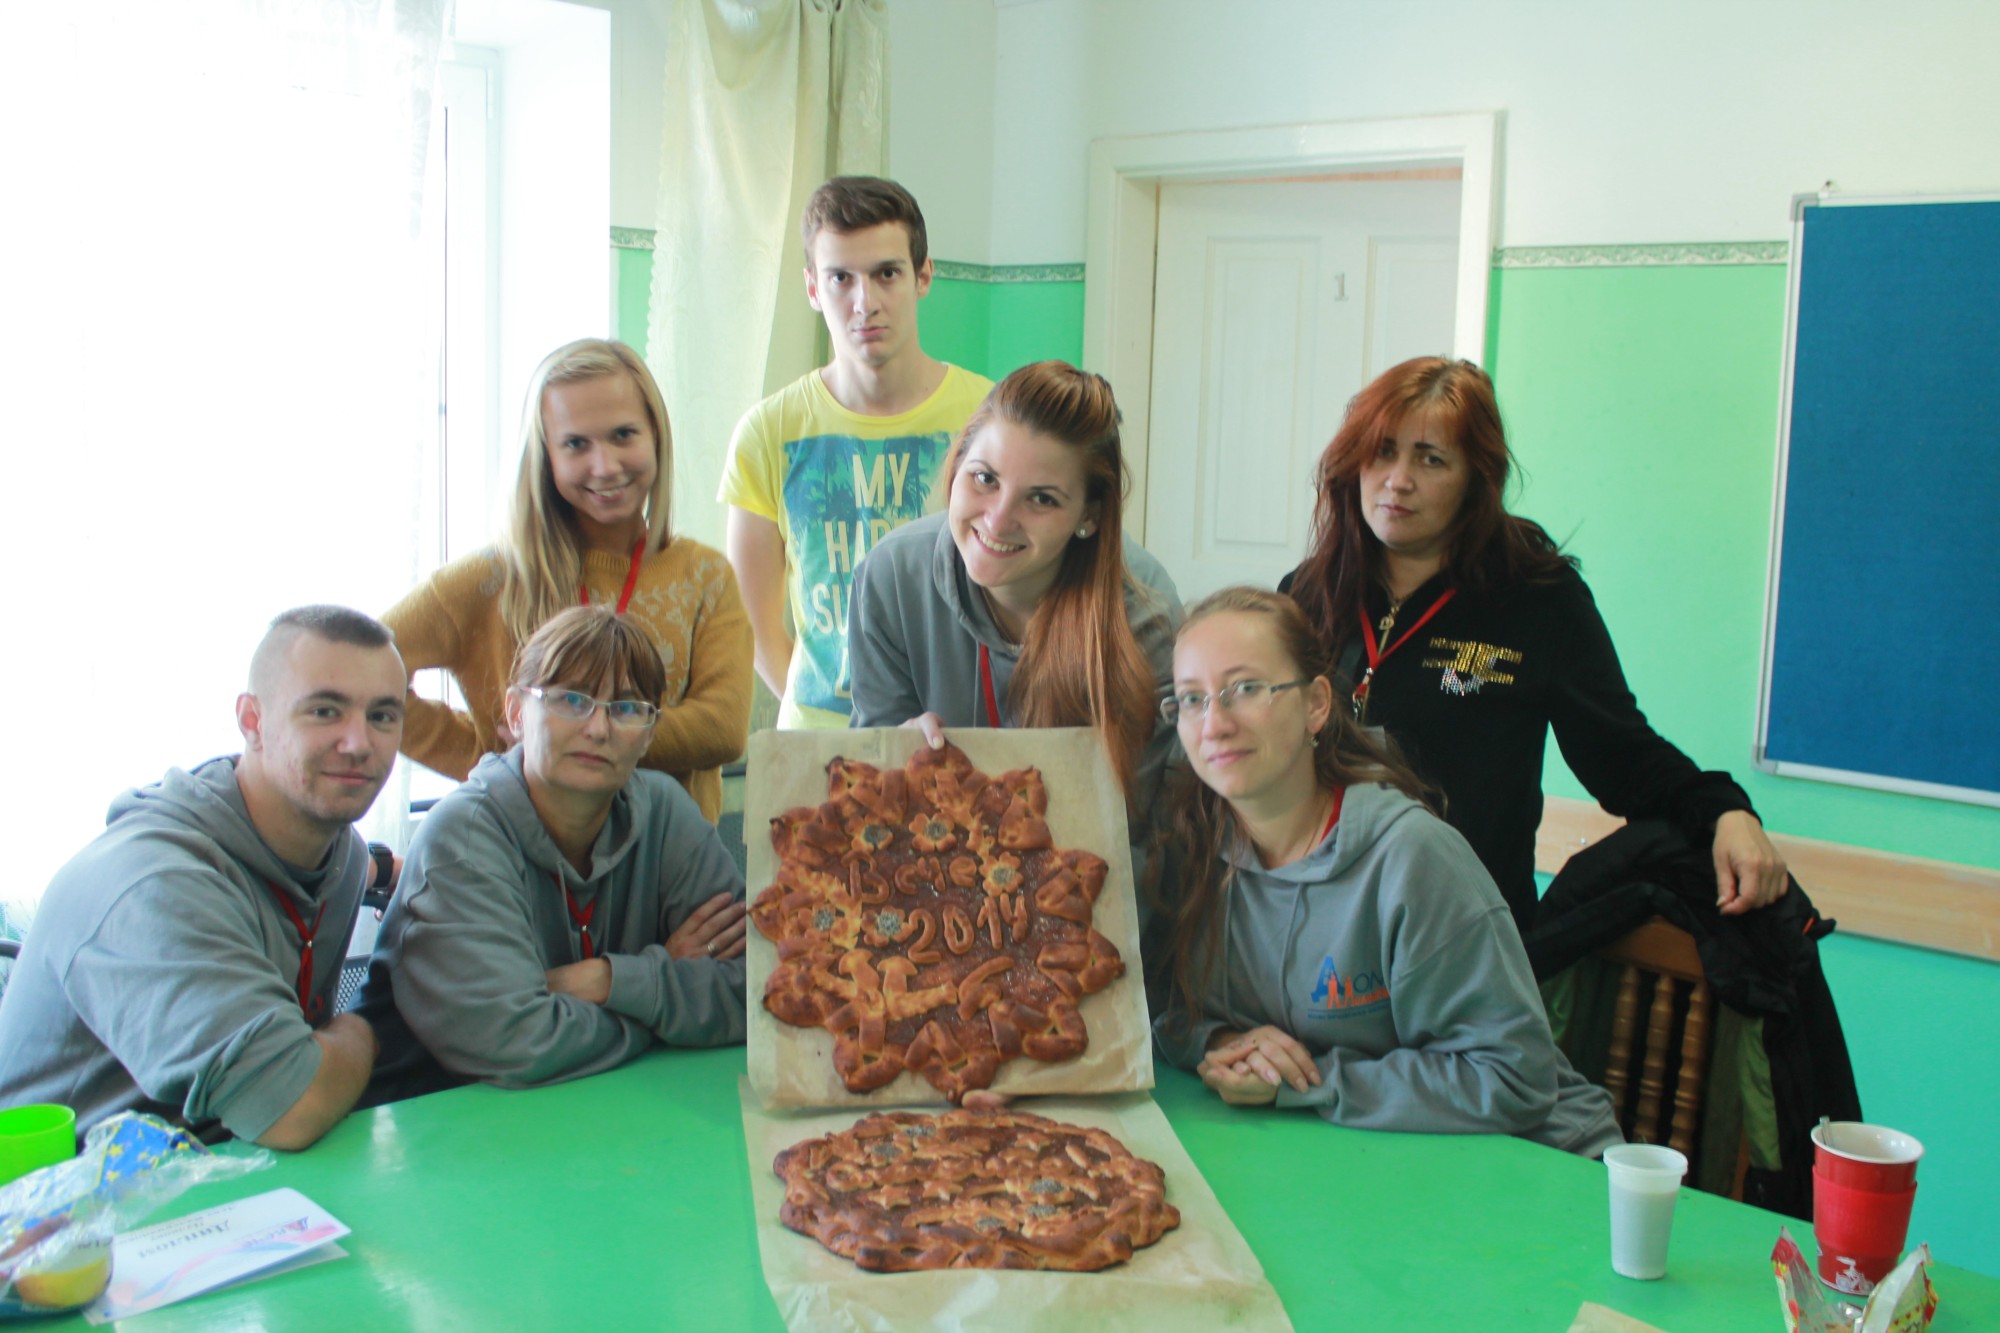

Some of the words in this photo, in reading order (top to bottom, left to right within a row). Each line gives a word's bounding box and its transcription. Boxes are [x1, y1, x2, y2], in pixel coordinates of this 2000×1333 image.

[1333, 272, 1350, 302] 1
[852, 453, 911, 508] MY
[908, 893, 1028, 964] 2014
